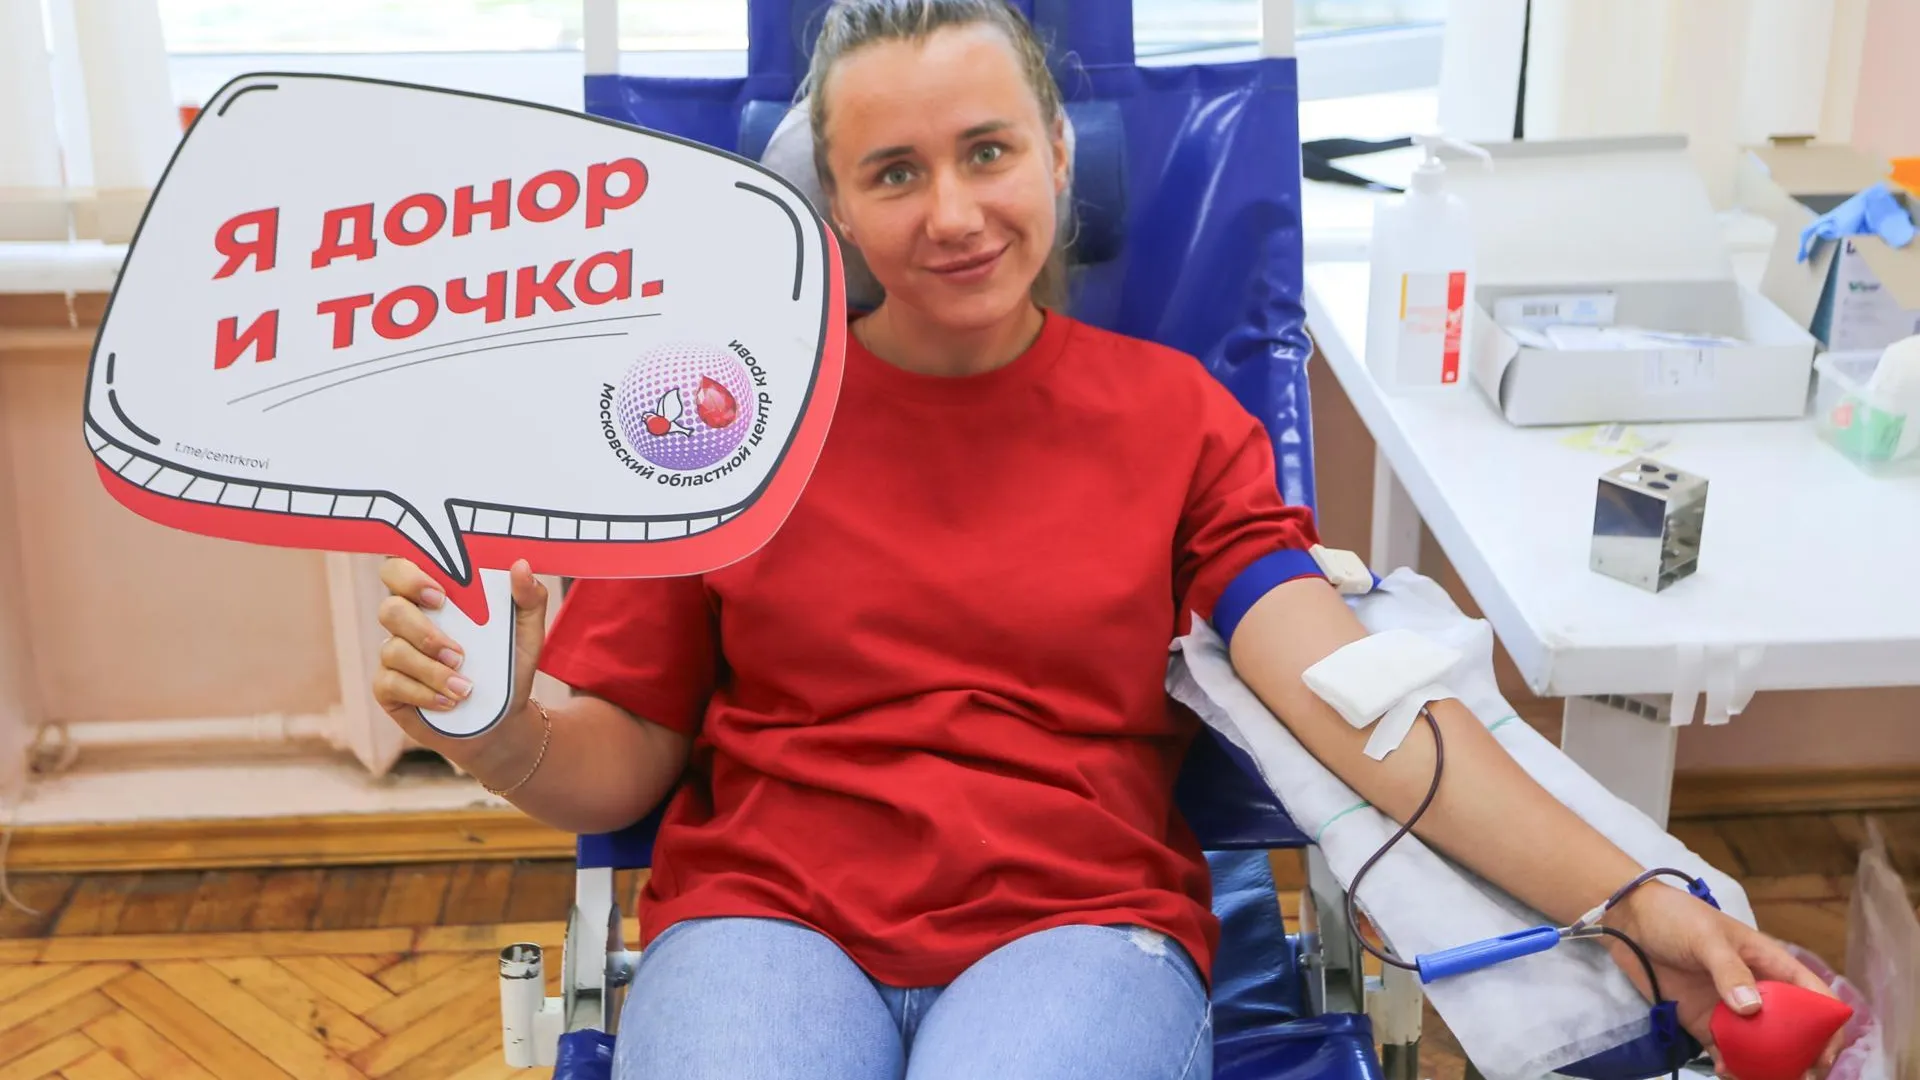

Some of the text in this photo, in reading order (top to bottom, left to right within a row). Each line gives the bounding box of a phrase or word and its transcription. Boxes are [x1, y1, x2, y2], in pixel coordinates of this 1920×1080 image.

[211, 157, 650, 281] Я донор
[213, 248, 664, 370] и точка.
[174, 441, 270, 470] t.me/centrkrovi
[600, 339, 773, 488] Московский областной центр крови
